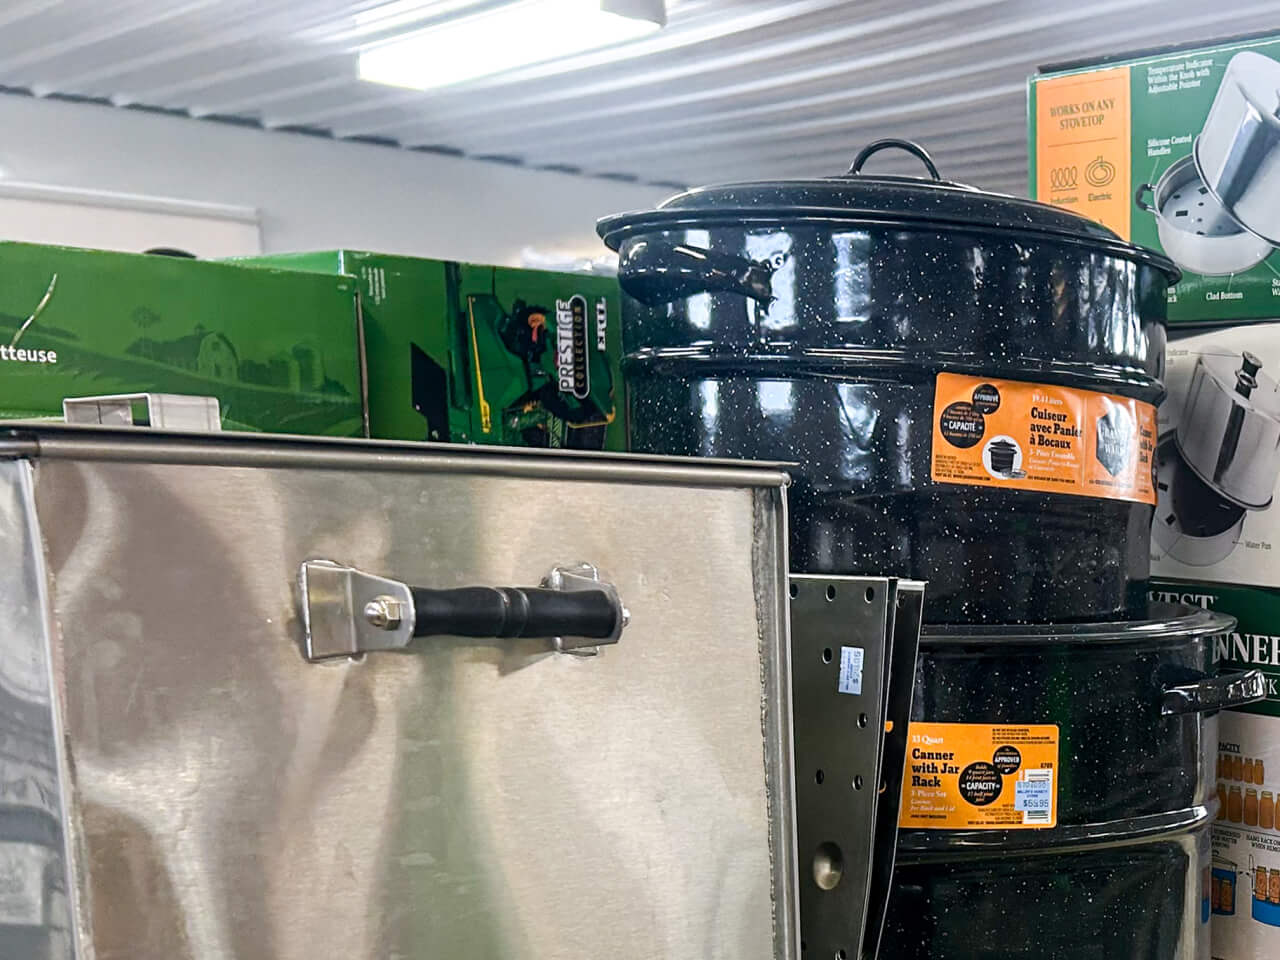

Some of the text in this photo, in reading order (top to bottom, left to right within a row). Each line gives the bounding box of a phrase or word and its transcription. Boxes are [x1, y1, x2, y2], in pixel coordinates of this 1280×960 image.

[1059, 115, 1104, 129] STOVETOP
[556, 298, 574, 393] PRESTIGE
[574, 305, 584, 389] COLLECTION
[1031, 407, 1067, 422] Cuiseur
[1030, 423, 1082, 437] avec Panier
[1038, 437, 1071, 449] Bocaux
[912, 748, 954, 760] Canner
[912, 762, 959, 774] with Jar
[912, 775, 941, 787] Rack
[967, 782, 996, 791] CAPACITY
